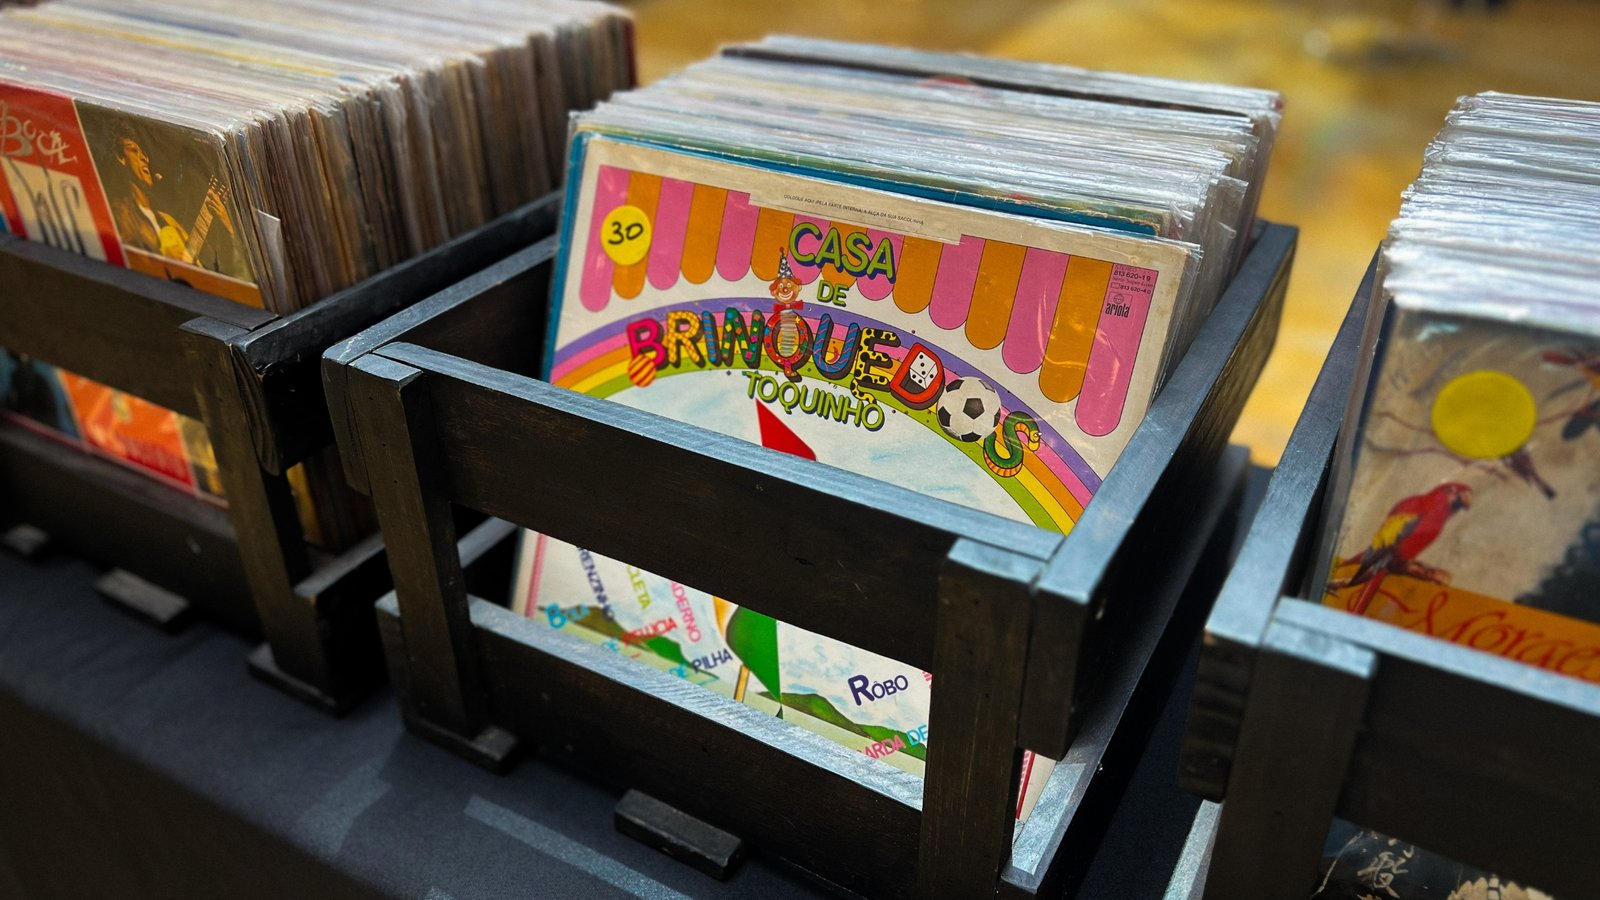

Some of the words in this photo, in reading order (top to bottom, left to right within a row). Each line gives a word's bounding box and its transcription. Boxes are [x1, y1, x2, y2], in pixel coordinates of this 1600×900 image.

[608, 221, 644, 245] 30
[789, 222, 896, 284] CASA
[816, 279, 850, 307] DE
[1105, 302, 1130, 318] ariola
[626, 306, 1040, 477] BRINQUEDOS
[745, 371, 885, 431] TOQUINHO
[691, 648, 734, 674] PILHA
[906, 724, 928, 747] DE
